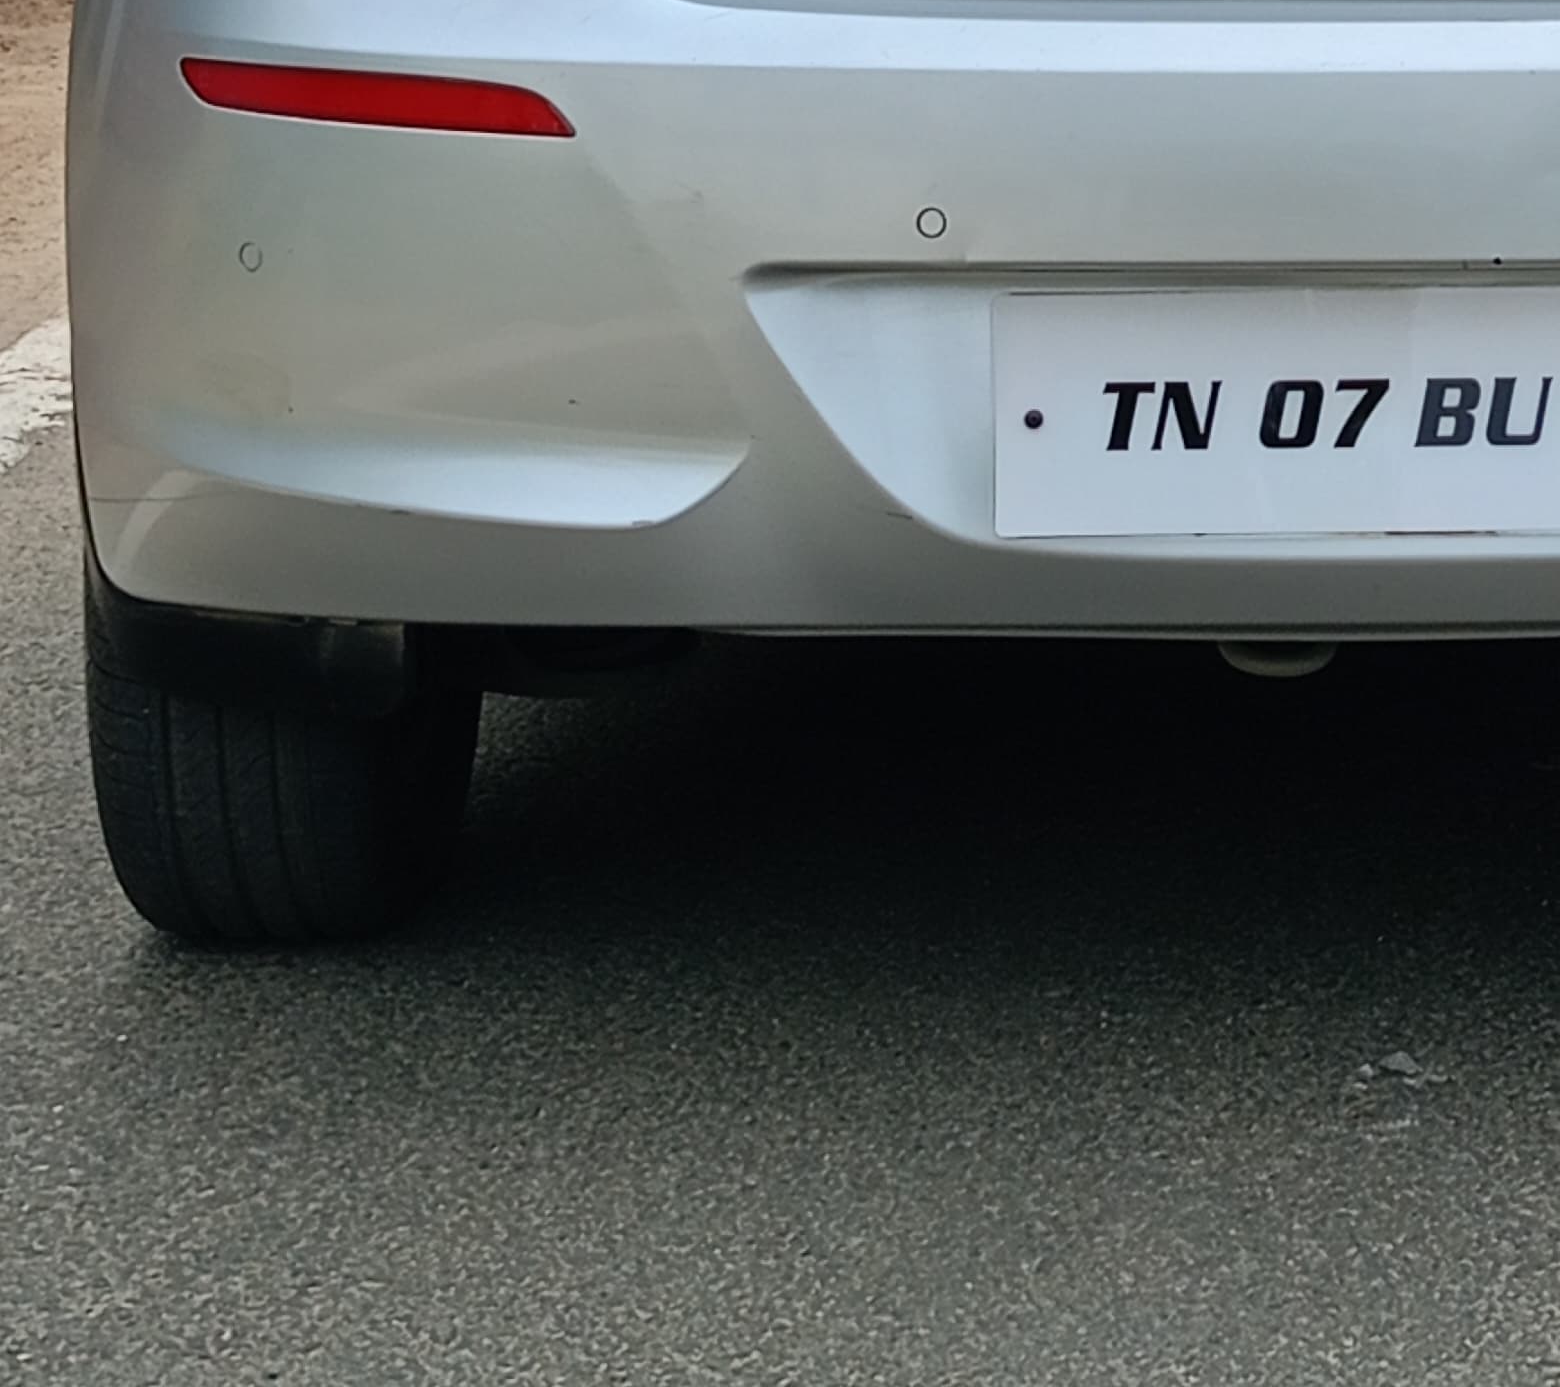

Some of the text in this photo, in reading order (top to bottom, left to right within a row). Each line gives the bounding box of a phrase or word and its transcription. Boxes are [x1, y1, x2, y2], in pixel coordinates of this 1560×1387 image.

[1102, 380, 1223, 452] TN
[1259, 378, 1390, 449] 07
[1414, 376, 1553, 448] BU
